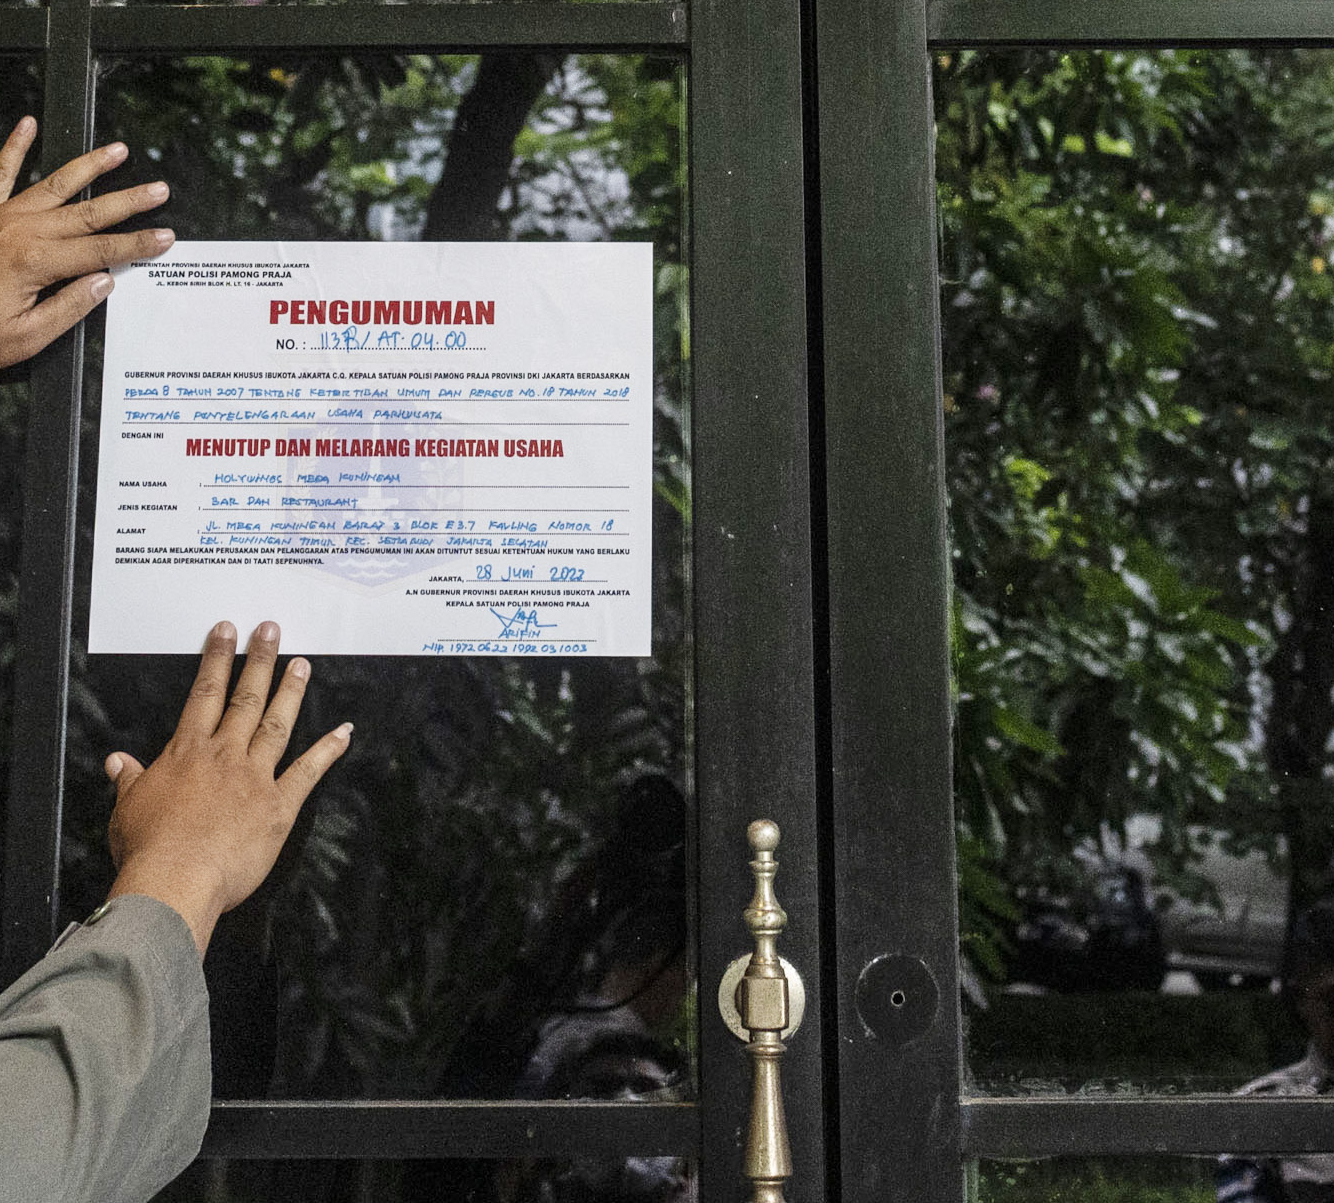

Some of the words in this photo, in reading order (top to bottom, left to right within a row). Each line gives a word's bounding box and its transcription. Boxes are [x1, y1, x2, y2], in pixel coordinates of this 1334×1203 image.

[270, 300, 494, 325] PENGUMUMAN
[276, 339, 298, 350] NO.
[125, 372, 164, 380] GUBERNUR
[167, 372, 200, 380] PROVINSI
[203, 372, 231, 380] DAERAH
[234, 372, 263, 380] KHUSUS
[265, 372, 296, 380] IBUKOTA
[163, 385, 169, 396] 8
[177, 388, 211, 398] TAHUN
[217, 388, 243, 398] 2007
[249, 388, 300, 398] TENTANG
[438, 387, 461, 397] DAN
[560, 388, 597, 398] TAHUN
[603, 388, 630, 398] 2018
[187, 439, 270, 458] MENUTUP
[275, 439, 313, 457] DAN
[315, 439, 410, 458] MELARANG
[415, 439, 499, 457] KEGIATAN
[504, 438, 563, 457] USAHA
[212, 497, 238, 506] BAR
[247, 497, 270, 507] DAN
[601, 519, 614, 532] 18
[477, 564, 491, 580] 28
[429, 576, 464, 584] JAKARTA,
